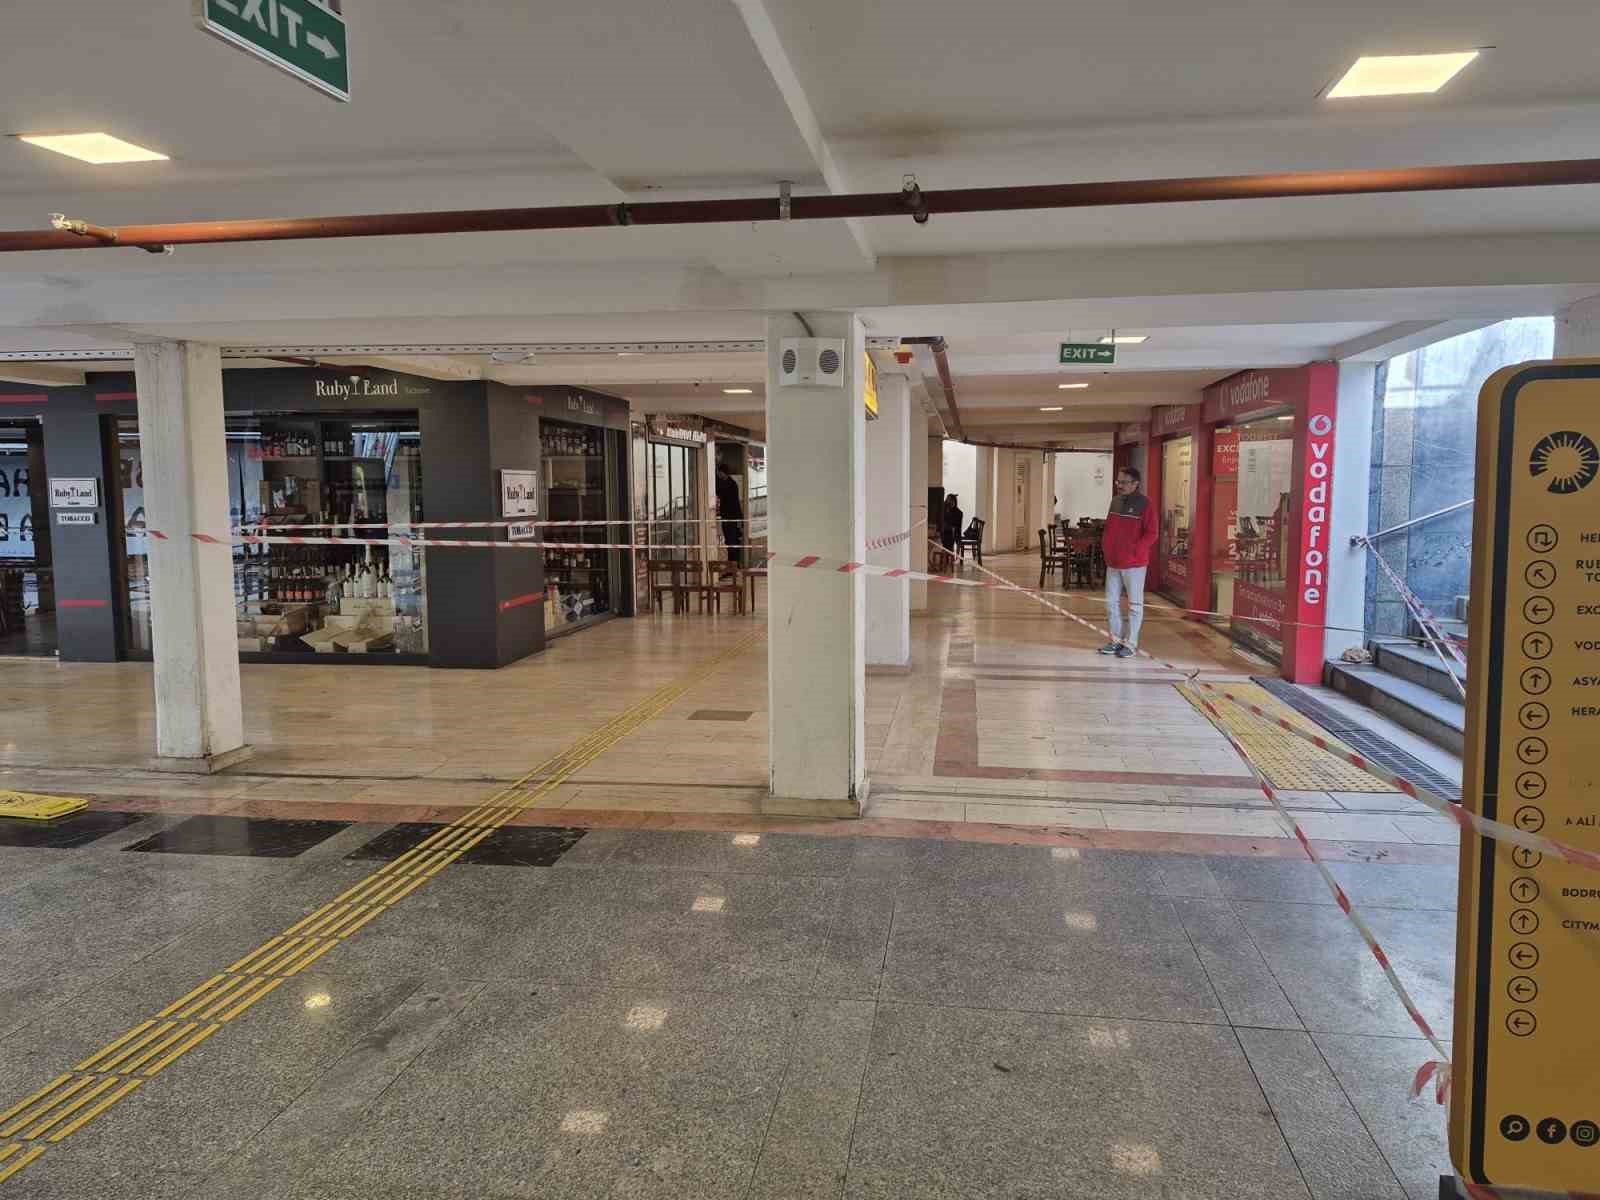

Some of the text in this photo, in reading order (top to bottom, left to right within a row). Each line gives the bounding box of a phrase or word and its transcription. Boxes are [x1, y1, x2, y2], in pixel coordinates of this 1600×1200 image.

[212, 0, 303, 48] XIT
[1063, 347, 1097, 359] EXIT
[315, 379, 351, 401] Ruby
[363, 378, 399, 396] Land
[1230, 372, 1270, 405] vodafone
[55, 488, 92, 500] Ruby Land
[1303, 443, 1329, 605] vodafone
